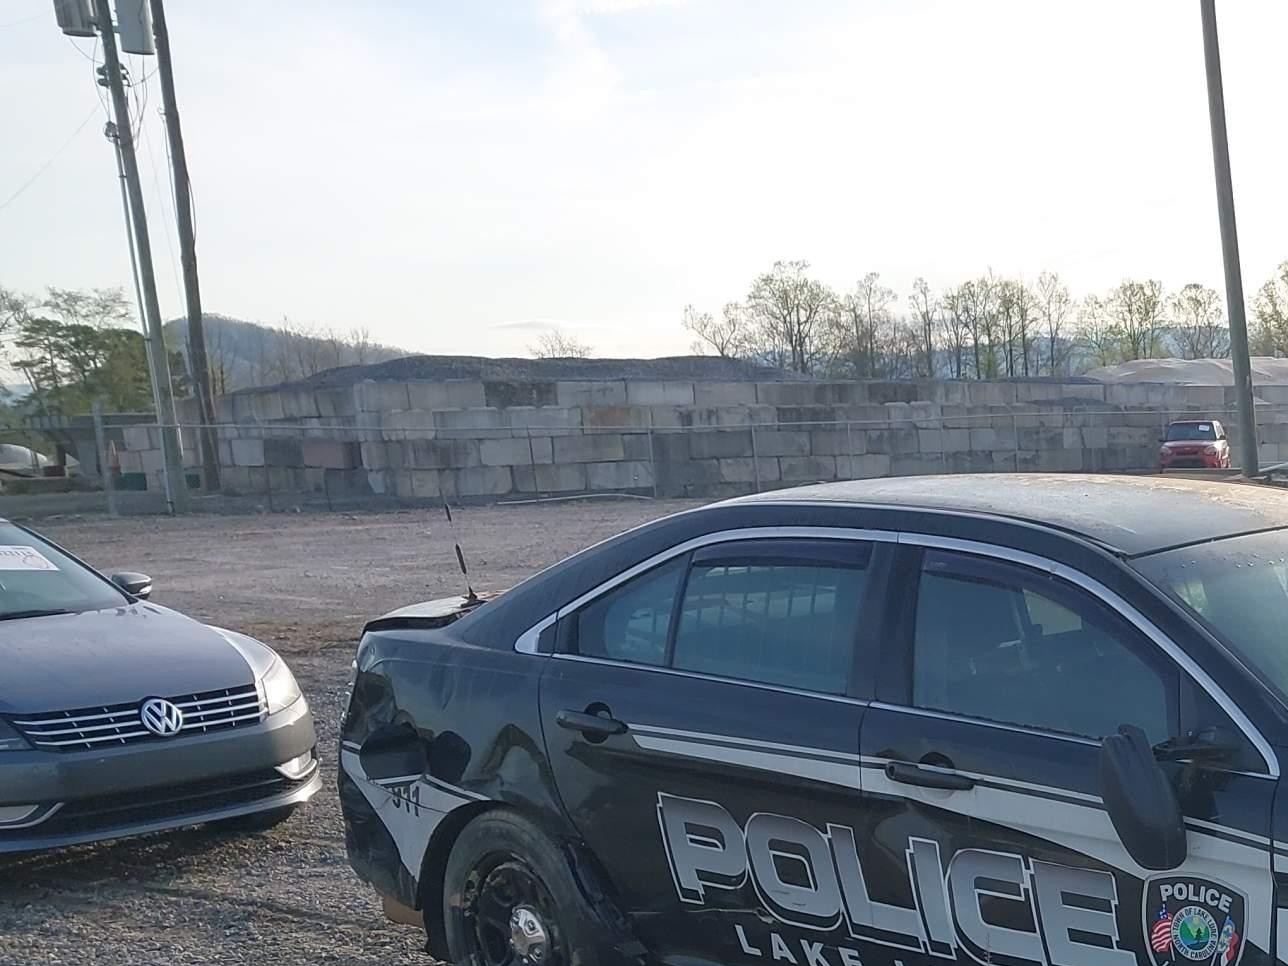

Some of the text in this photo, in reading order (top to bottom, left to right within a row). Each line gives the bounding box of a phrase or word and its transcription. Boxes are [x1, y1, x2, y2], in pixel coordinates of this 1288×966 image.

[1159, 882, 1233, 913] POLICE
[1173, 907, 1218, 938] TOWN OF LAKE LURE
[1173, 934, 1217, 959] NORTH CAROLINA
